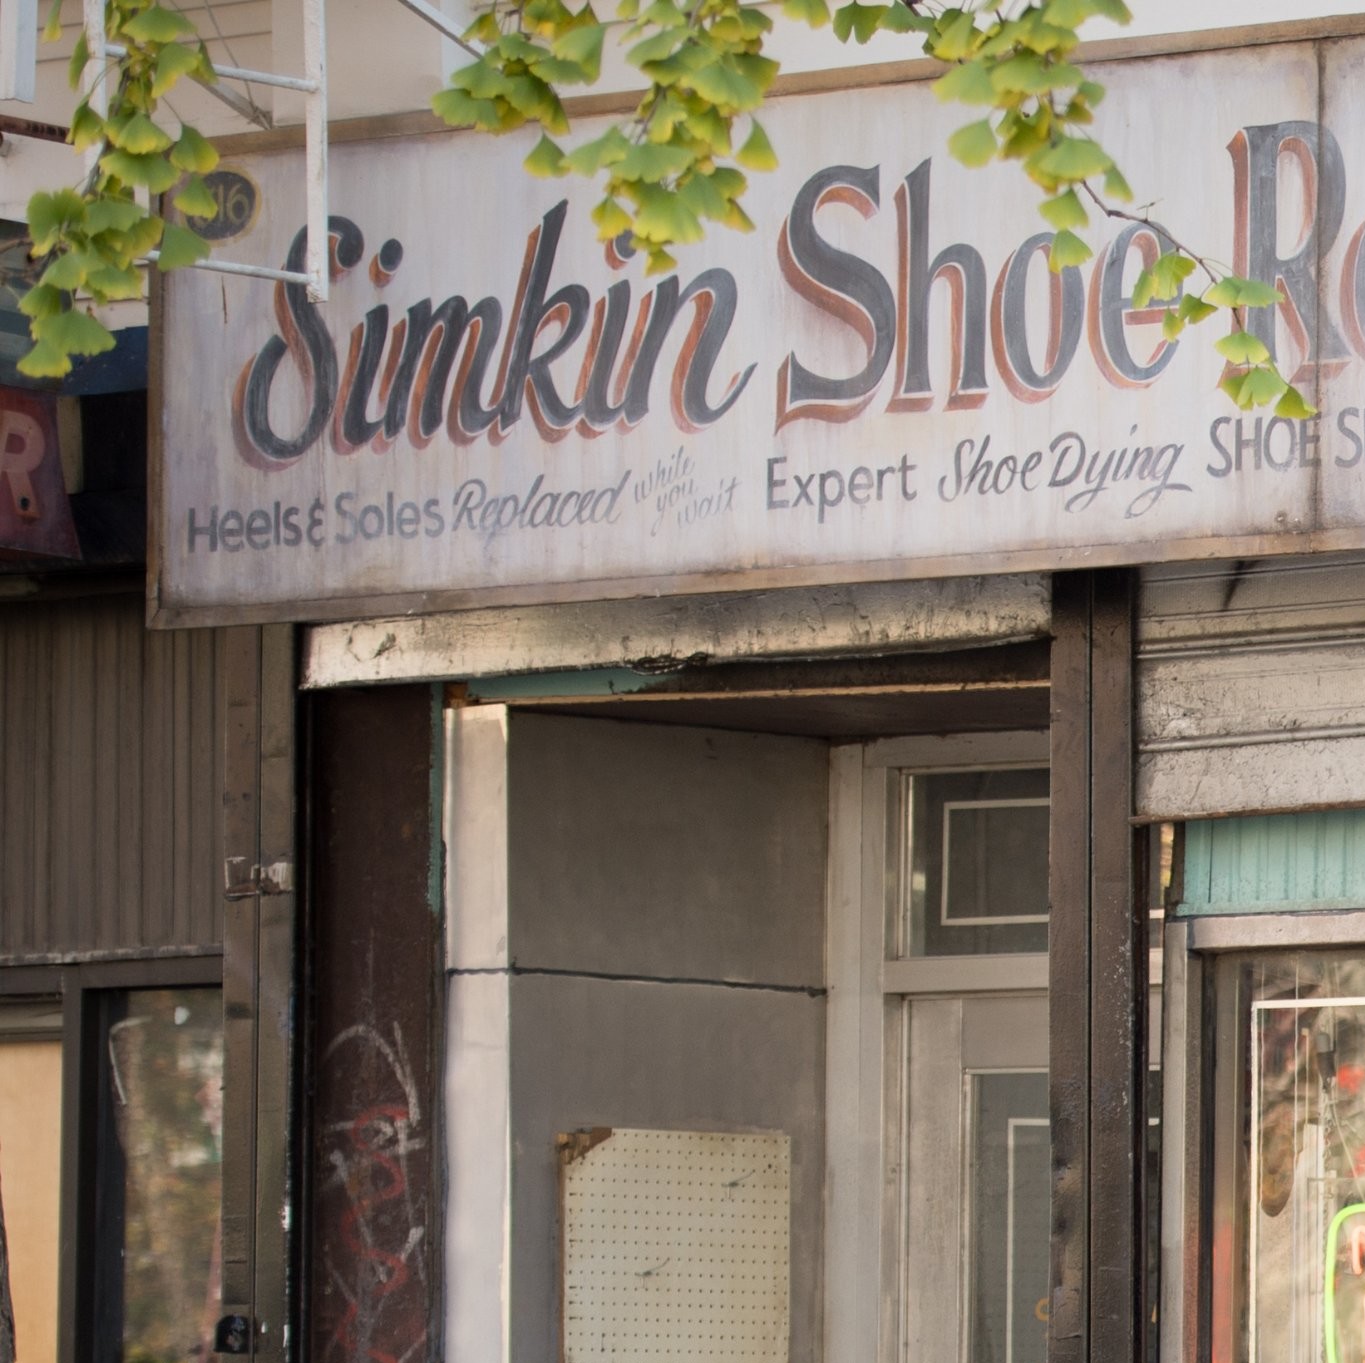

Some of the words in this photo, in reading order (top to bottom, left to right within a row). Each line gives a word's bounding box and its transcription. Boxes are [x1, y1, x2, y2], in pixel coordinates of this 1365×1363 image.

[193, 183, 250, 227] 16
[234, 199, 758, 471] Simkin
[776, 159, 1182, 435] Shoe
[633, 446, 697, 502] while
[766, 452, 919, 525] Expert
[938, 434, 1044, 502] Shoe
[1046, 423, 1194, 521] Dying
[1206, 414, 1321, 478] SHOE
[187, 501, 301, 553] Heels
[333, 490, 444, 546] Soles
[451, 470, 633, 552] Replaced
[677, 474, 742, 530] wait
